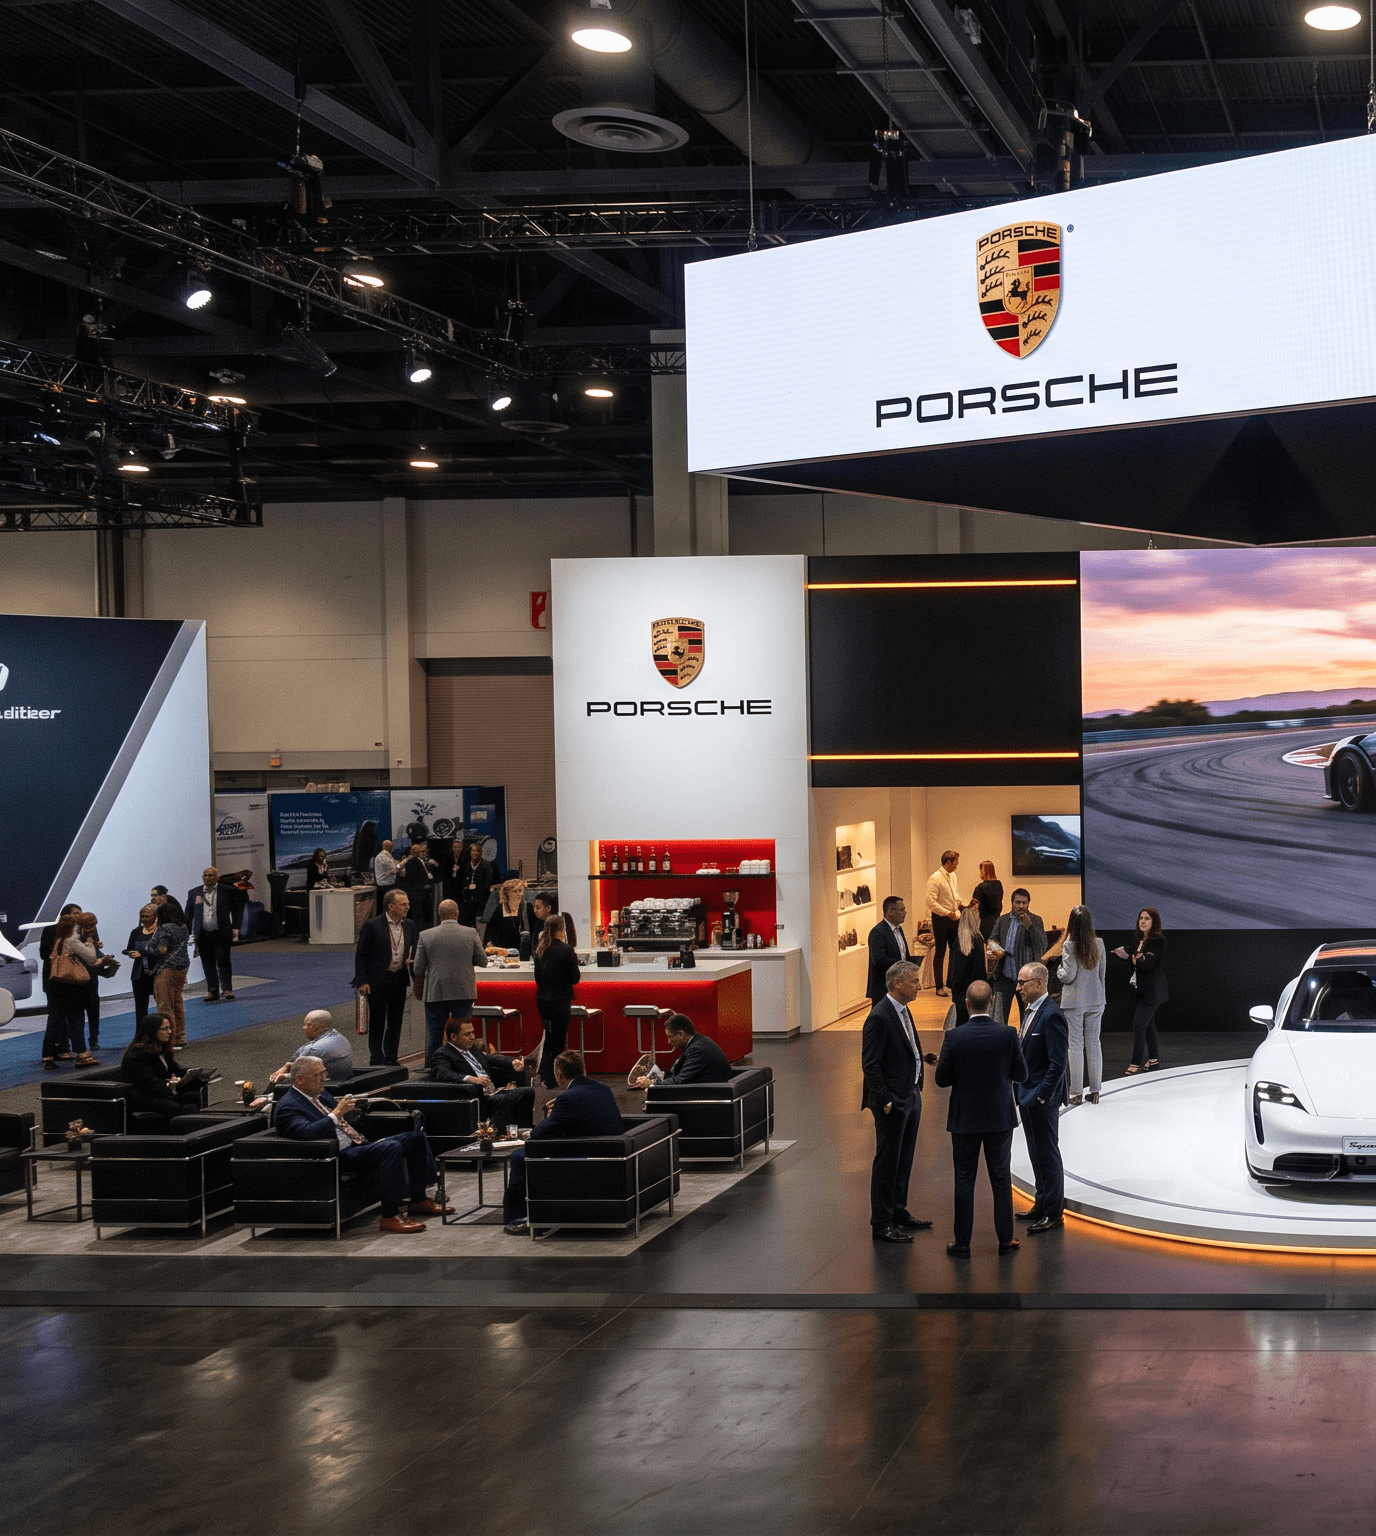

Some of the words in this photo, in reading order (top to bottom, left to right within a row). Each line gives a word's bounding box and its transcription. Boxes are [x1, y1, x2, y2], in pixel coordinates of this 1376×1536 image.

[978, 225, 1057, 252] PORSCHE
[875, 362, 1178, 428] PORSCHE
[586, 699, 772, 717] PORSCHE
